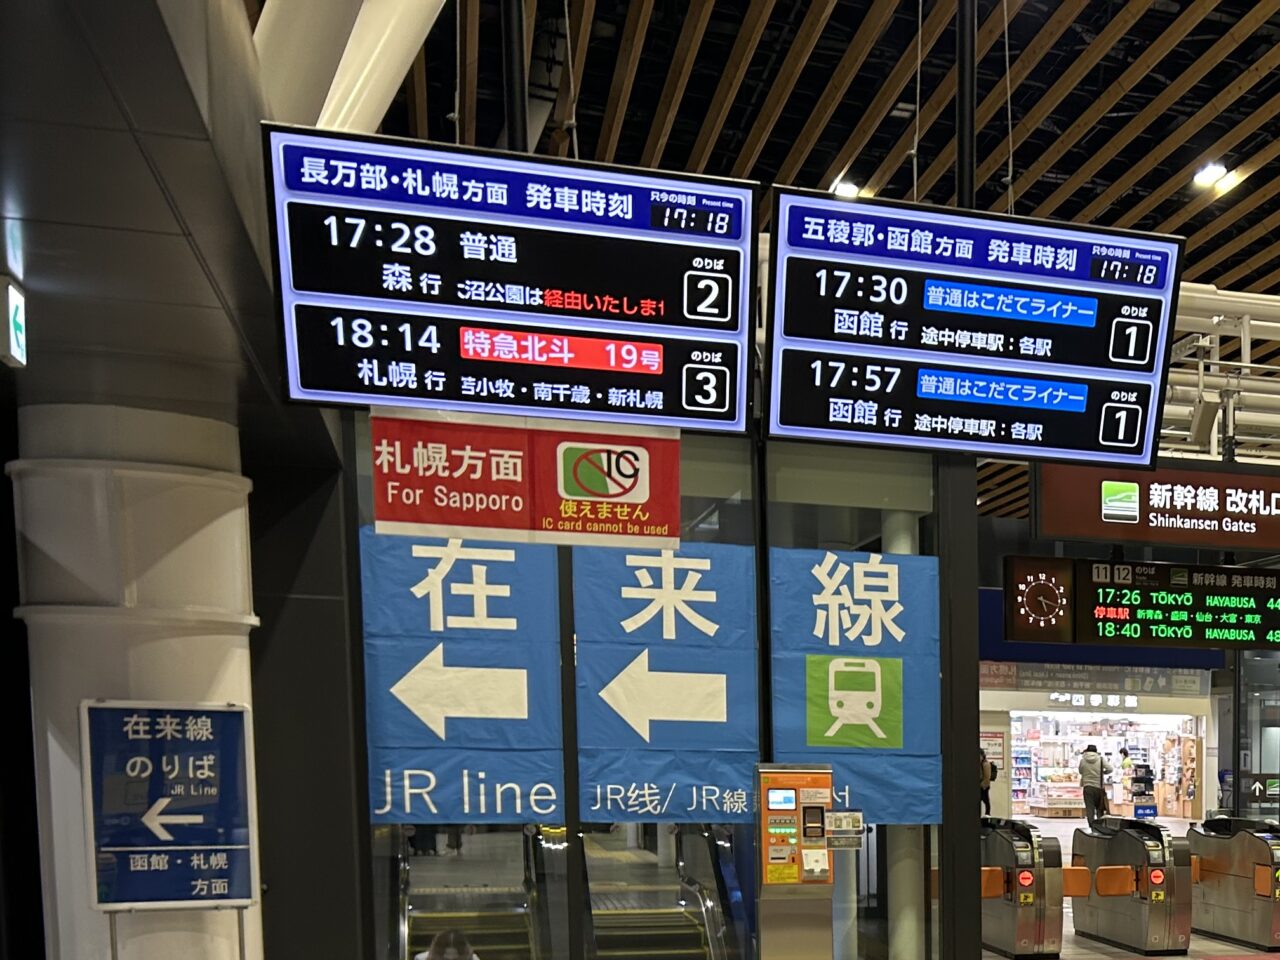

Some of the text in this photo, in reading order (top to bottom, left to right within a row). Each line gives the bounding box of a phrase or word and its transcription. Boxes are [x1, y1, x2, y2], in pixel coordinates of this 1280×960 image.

[526, 182, 634, 219] 発車時刻
[650, 191, 696, 206] 只今の時刻
[664, 207, 729, 234] 17:18
[323, 215, 519, 264] 17:28 普通
[692, 257, 724, 270] のりば
[988, 239, 1078, 271] 発車時刻
[382, 263, 414, 293] 森
[420, 273, 442, 295] 行
[1101, 260, 1157, 285] 17:18
[697, 279, 720, 314] 2
[815, 268, 1094, 318] 17:30 普通はこだてライナー
[833, 308, 884, 338] 函館
[890, 320, 908, 341] 行
[1121, 305, 1148, 317] のりば
[331, 316, 662, 371] 18:14 特急北斗 19号
[1124, 326, 1138, 357] 1
[691, 350, 723, 363] のりば
[358, 360, 417, 388] 札幌
[425, 371, 447, 392] 行
[695, 372, 718, 406] 3
[810, 360, 1085, 406] 17:57 普通はこだてライナー
[1111, 391, 1137, 402] のりば
[829, 397, 877, 427] 函館
[883, 408, 902, 429] 行
[1114, 410, 1127, 440] 1
[375, 439, 524, 483] 札幌方面
[387, 482, 524, 512] For Sapporo
[559, 500, 650, 521] 使えません
[1148, 482, 1219, 513] 新幹線
[542, 517, 669, 536] IC card cannot be used
[1149, 513, 1257, 534] Shinkansen Gates
[1094, 566, 1109, 582] 11
[1115, 567, 1131, 582] 12
[1097, 588, 1141, 605] 17:26
[1150, 592, 1193, 606] TŌKYŌ
[1206, 595, 1256, 609] HAYABUSA
[1094, 606, 1130, 620] 停車駅
[1097, 622, 1141, 638] 18:40
[1149, 624, 1193, 638] TŌKYŌ
[1205, 628, 1256, 641] HAYABUSA
[123, 714, 214, 741] 在来線
[126, 754, 216, 779] のりば
[171, 784, 218, 796] JR Line
[374, 769, 557, 815] JR line
[191, 878, 229, 896] 方面
